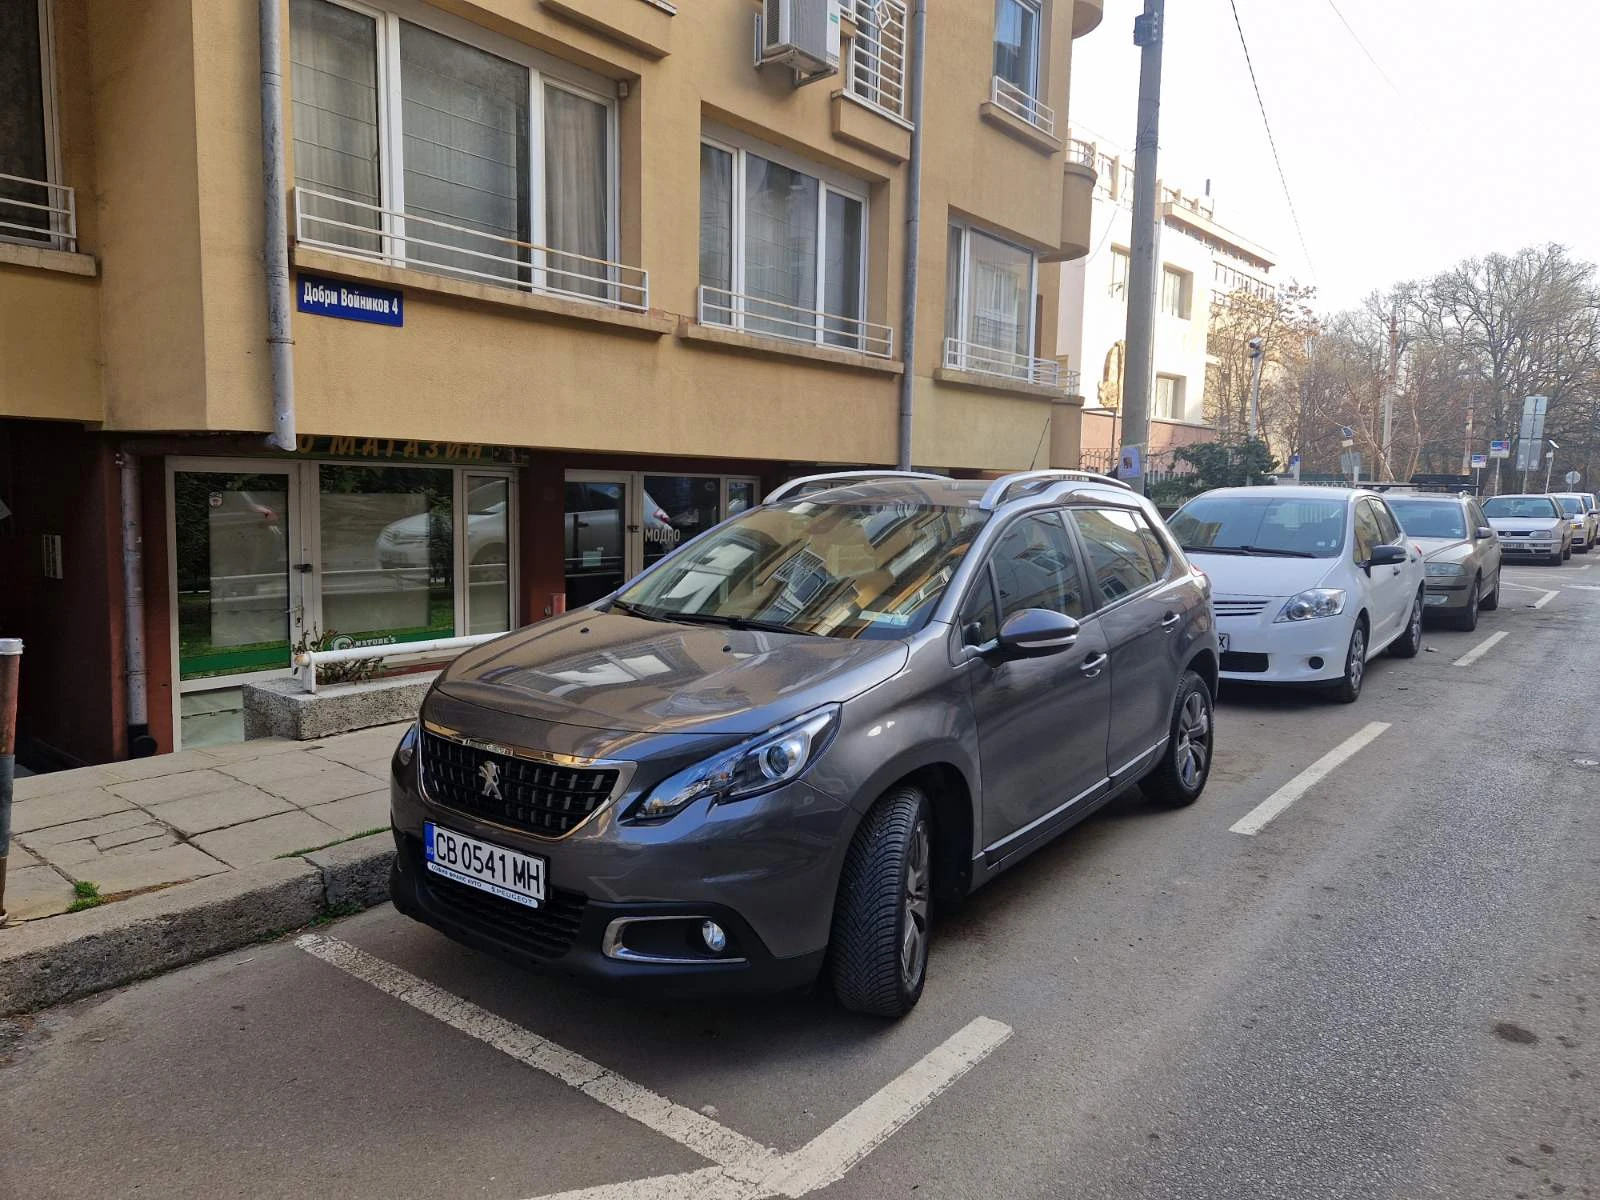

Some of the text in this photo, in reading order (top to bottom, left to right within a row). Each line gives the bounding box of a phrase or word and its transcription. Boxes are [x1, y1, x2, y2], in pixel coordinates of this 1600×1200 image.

[304, 282, 399, 315] Добри Войников 4
[329, 435, 483, 459] МАГАЗИН
[645, 529, 681, 543] МОДНО
[495, 887, 533, 905] PEUGEOT
